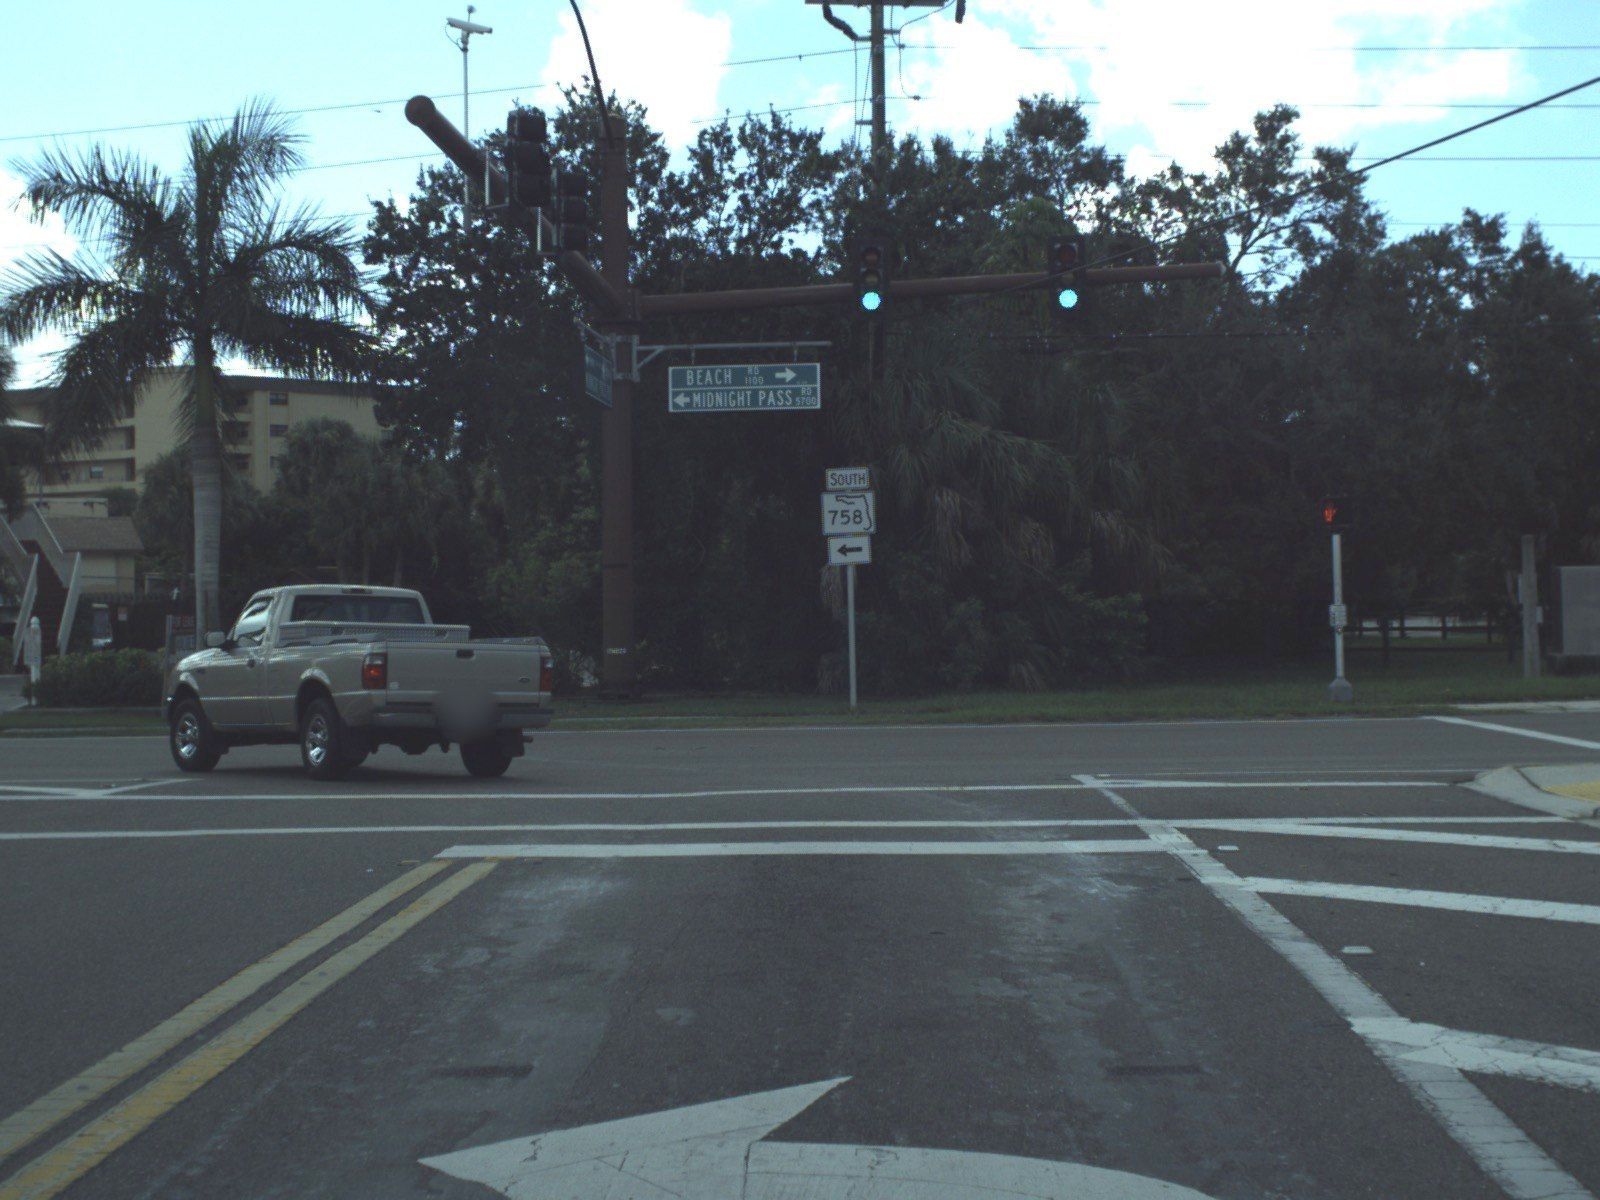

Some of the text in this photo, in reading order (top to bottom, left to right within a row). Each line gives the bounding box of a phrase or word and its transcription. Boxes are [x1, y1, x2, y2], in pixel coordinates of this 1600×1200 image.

[687, 368, 732, 386] BEACH
[801, 386, 812, 395] RD
[693, 390, 792, 408] MIDNIGHT PASS
[830, 472, 865, 486] SOUTH
[828, 509, 862, 525] 758
